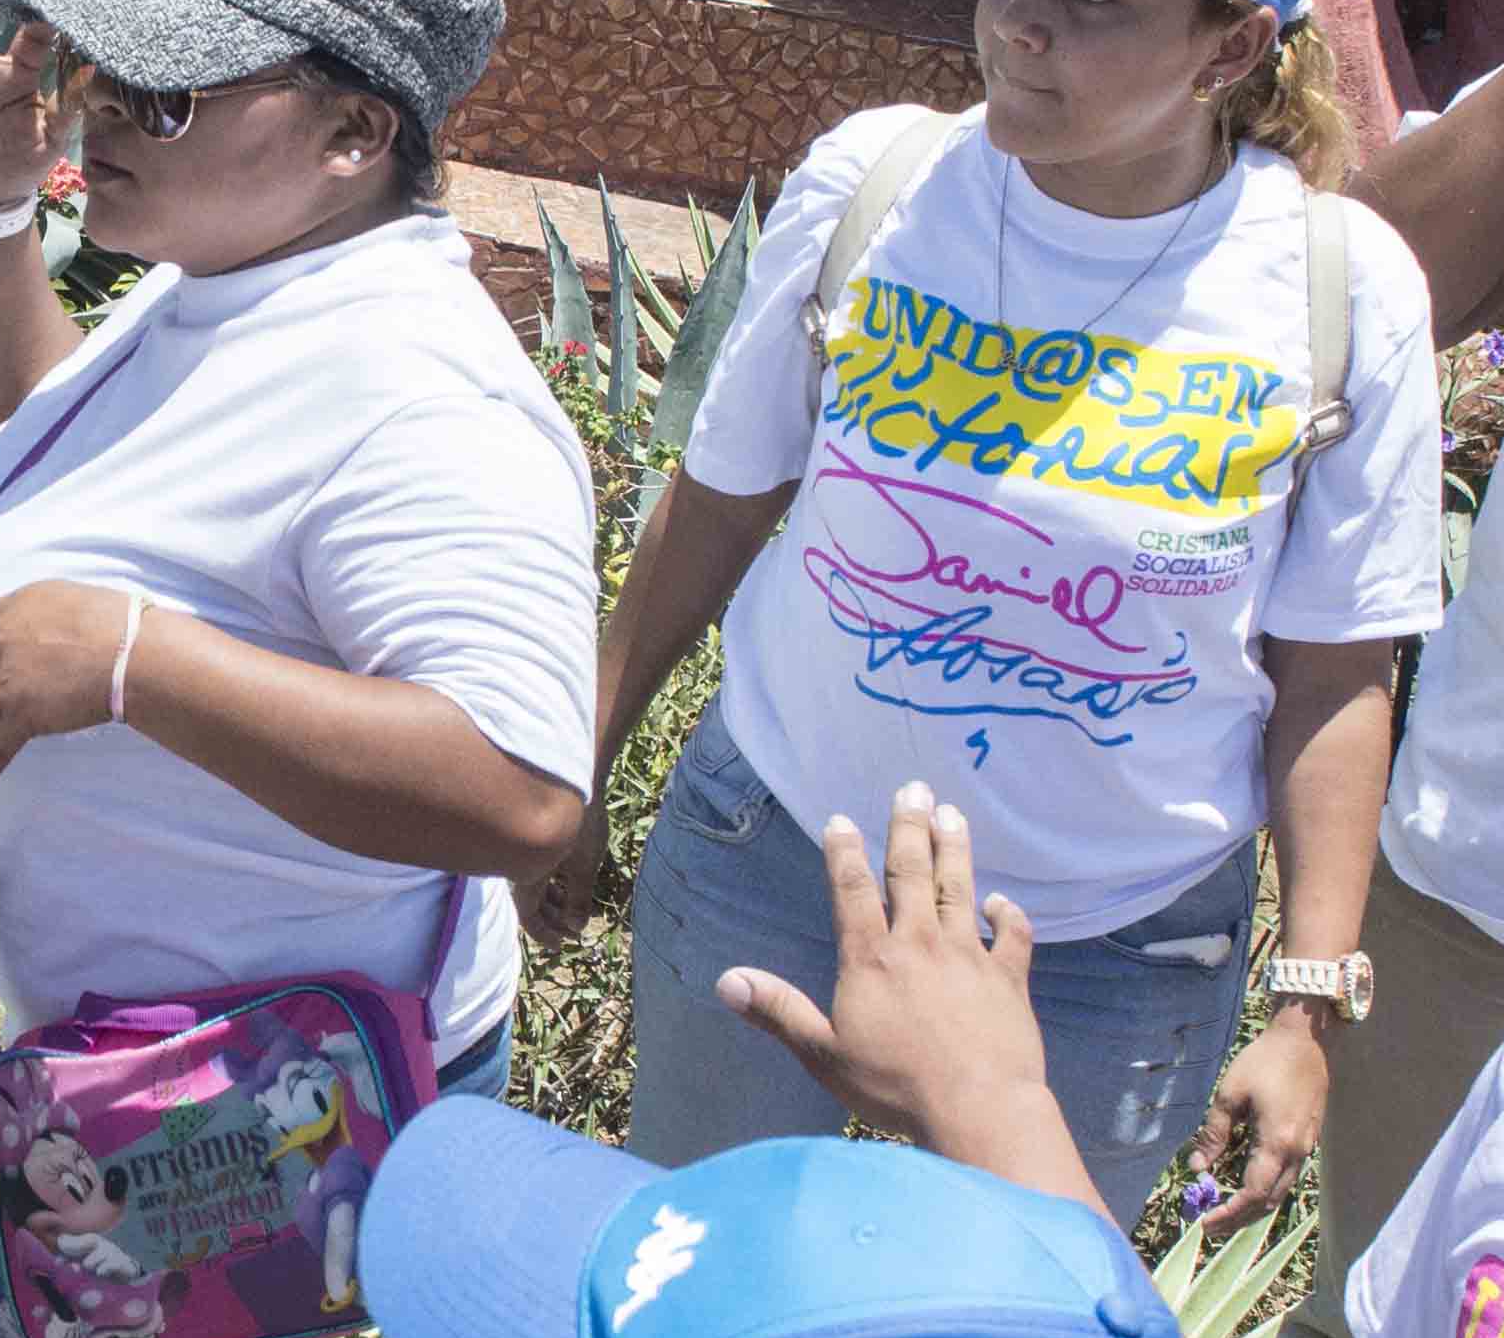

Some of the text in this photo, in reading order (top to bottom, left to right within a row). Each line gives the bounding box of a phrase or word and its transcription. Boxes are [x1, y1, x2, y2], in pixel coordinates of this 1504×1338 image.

[862, 276, 1282, 430] UNID@S EN
[1136, 527, 1251, 555] CRISTIANA
